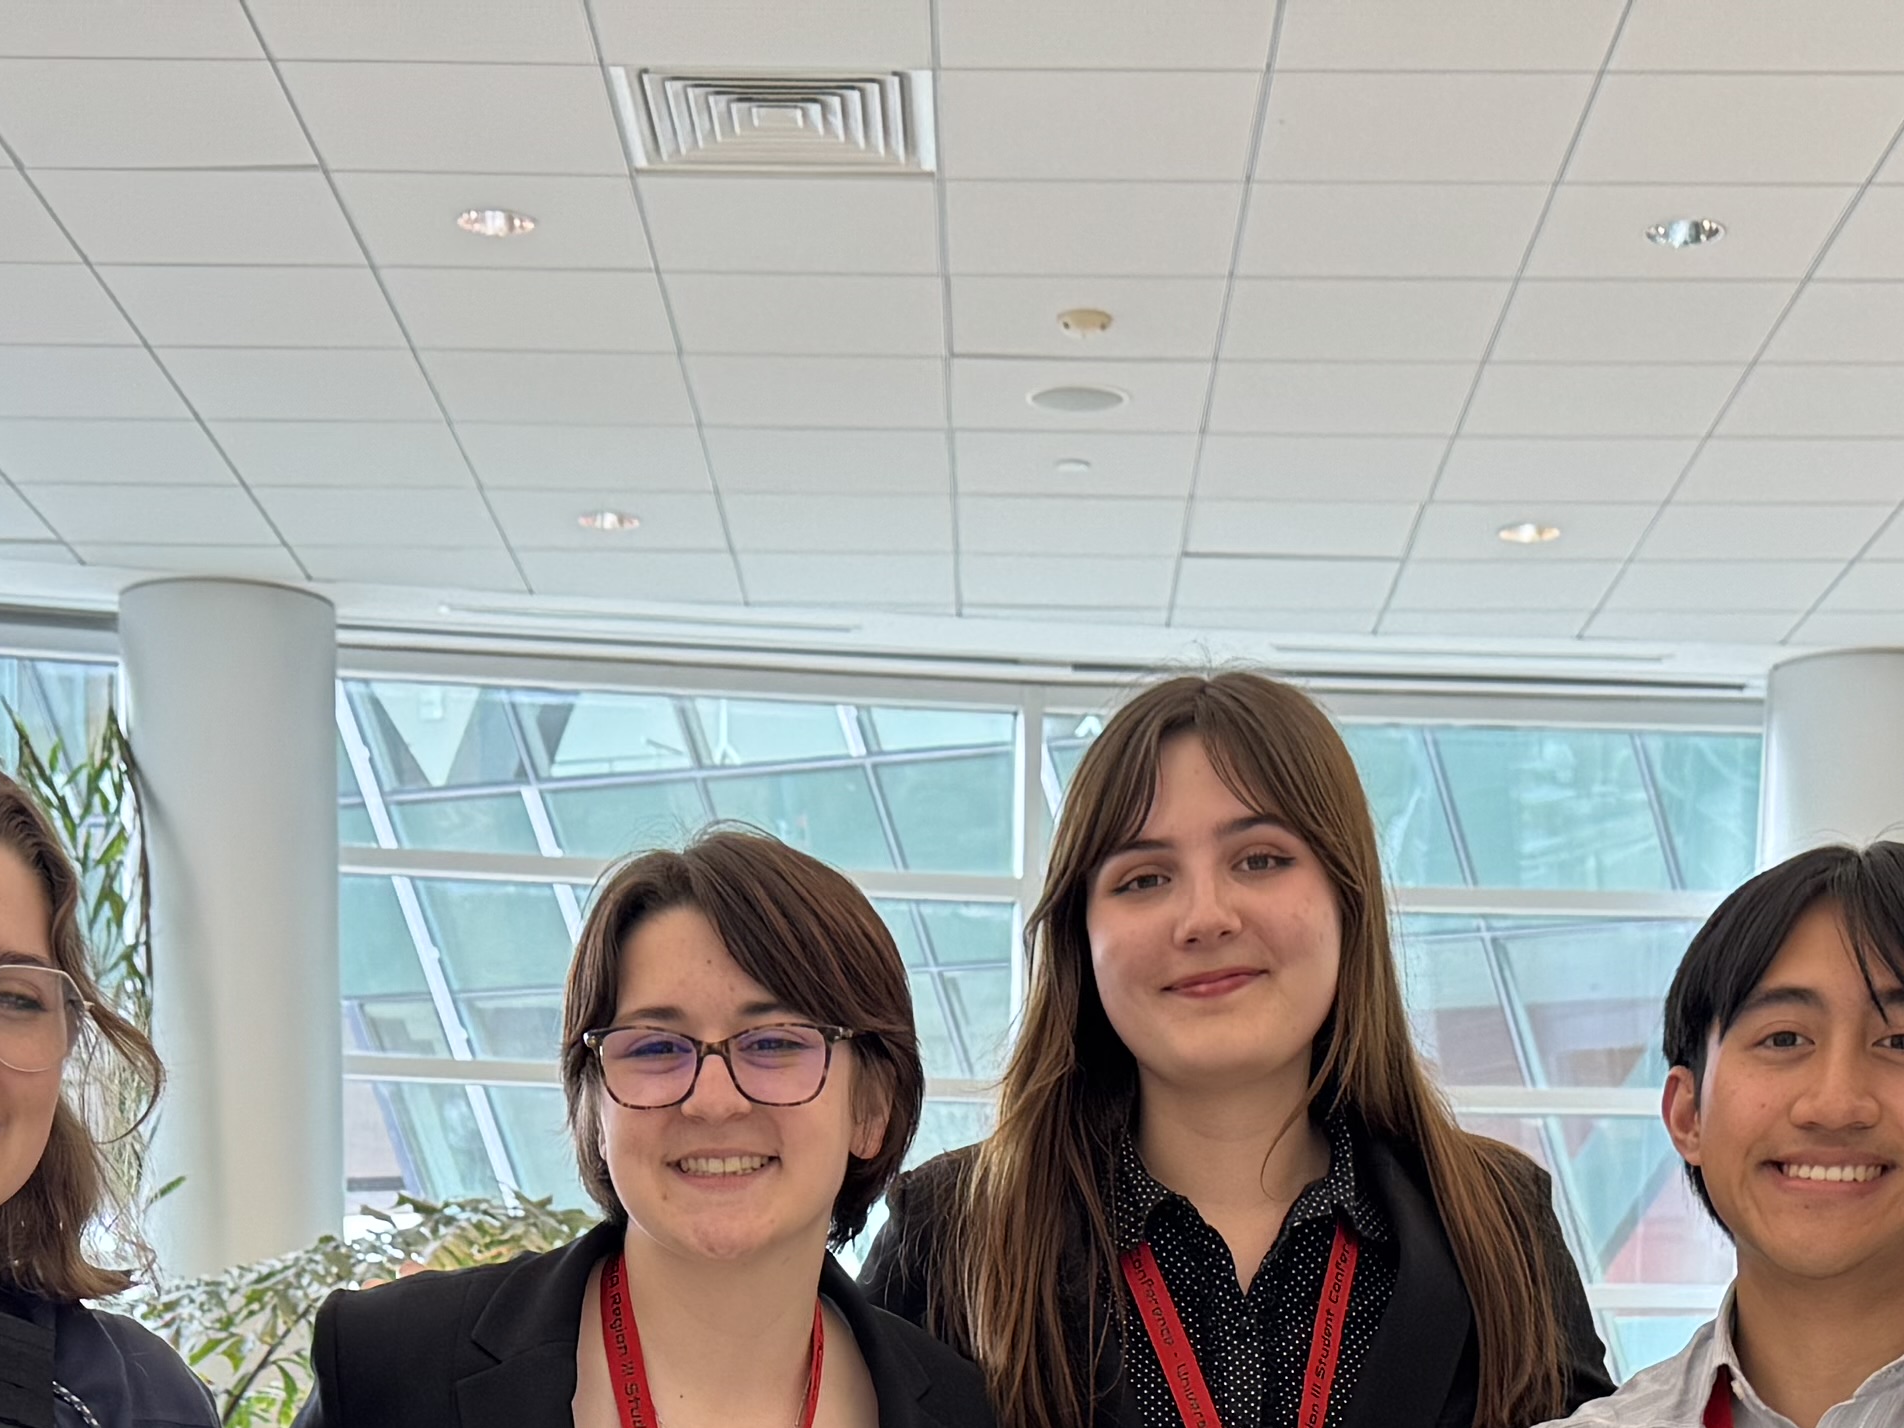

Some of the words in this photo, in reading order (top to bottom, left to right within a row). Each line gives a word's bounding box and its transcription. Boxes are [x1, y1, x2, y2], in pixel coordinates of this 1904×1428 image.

[1327, 1243, 1350, 1304] Confer
[610, 1291, 628, 1357] Region
[1315, 1312, 1334, 1379] Student
[1310, 1381, 1322, 1398] III
